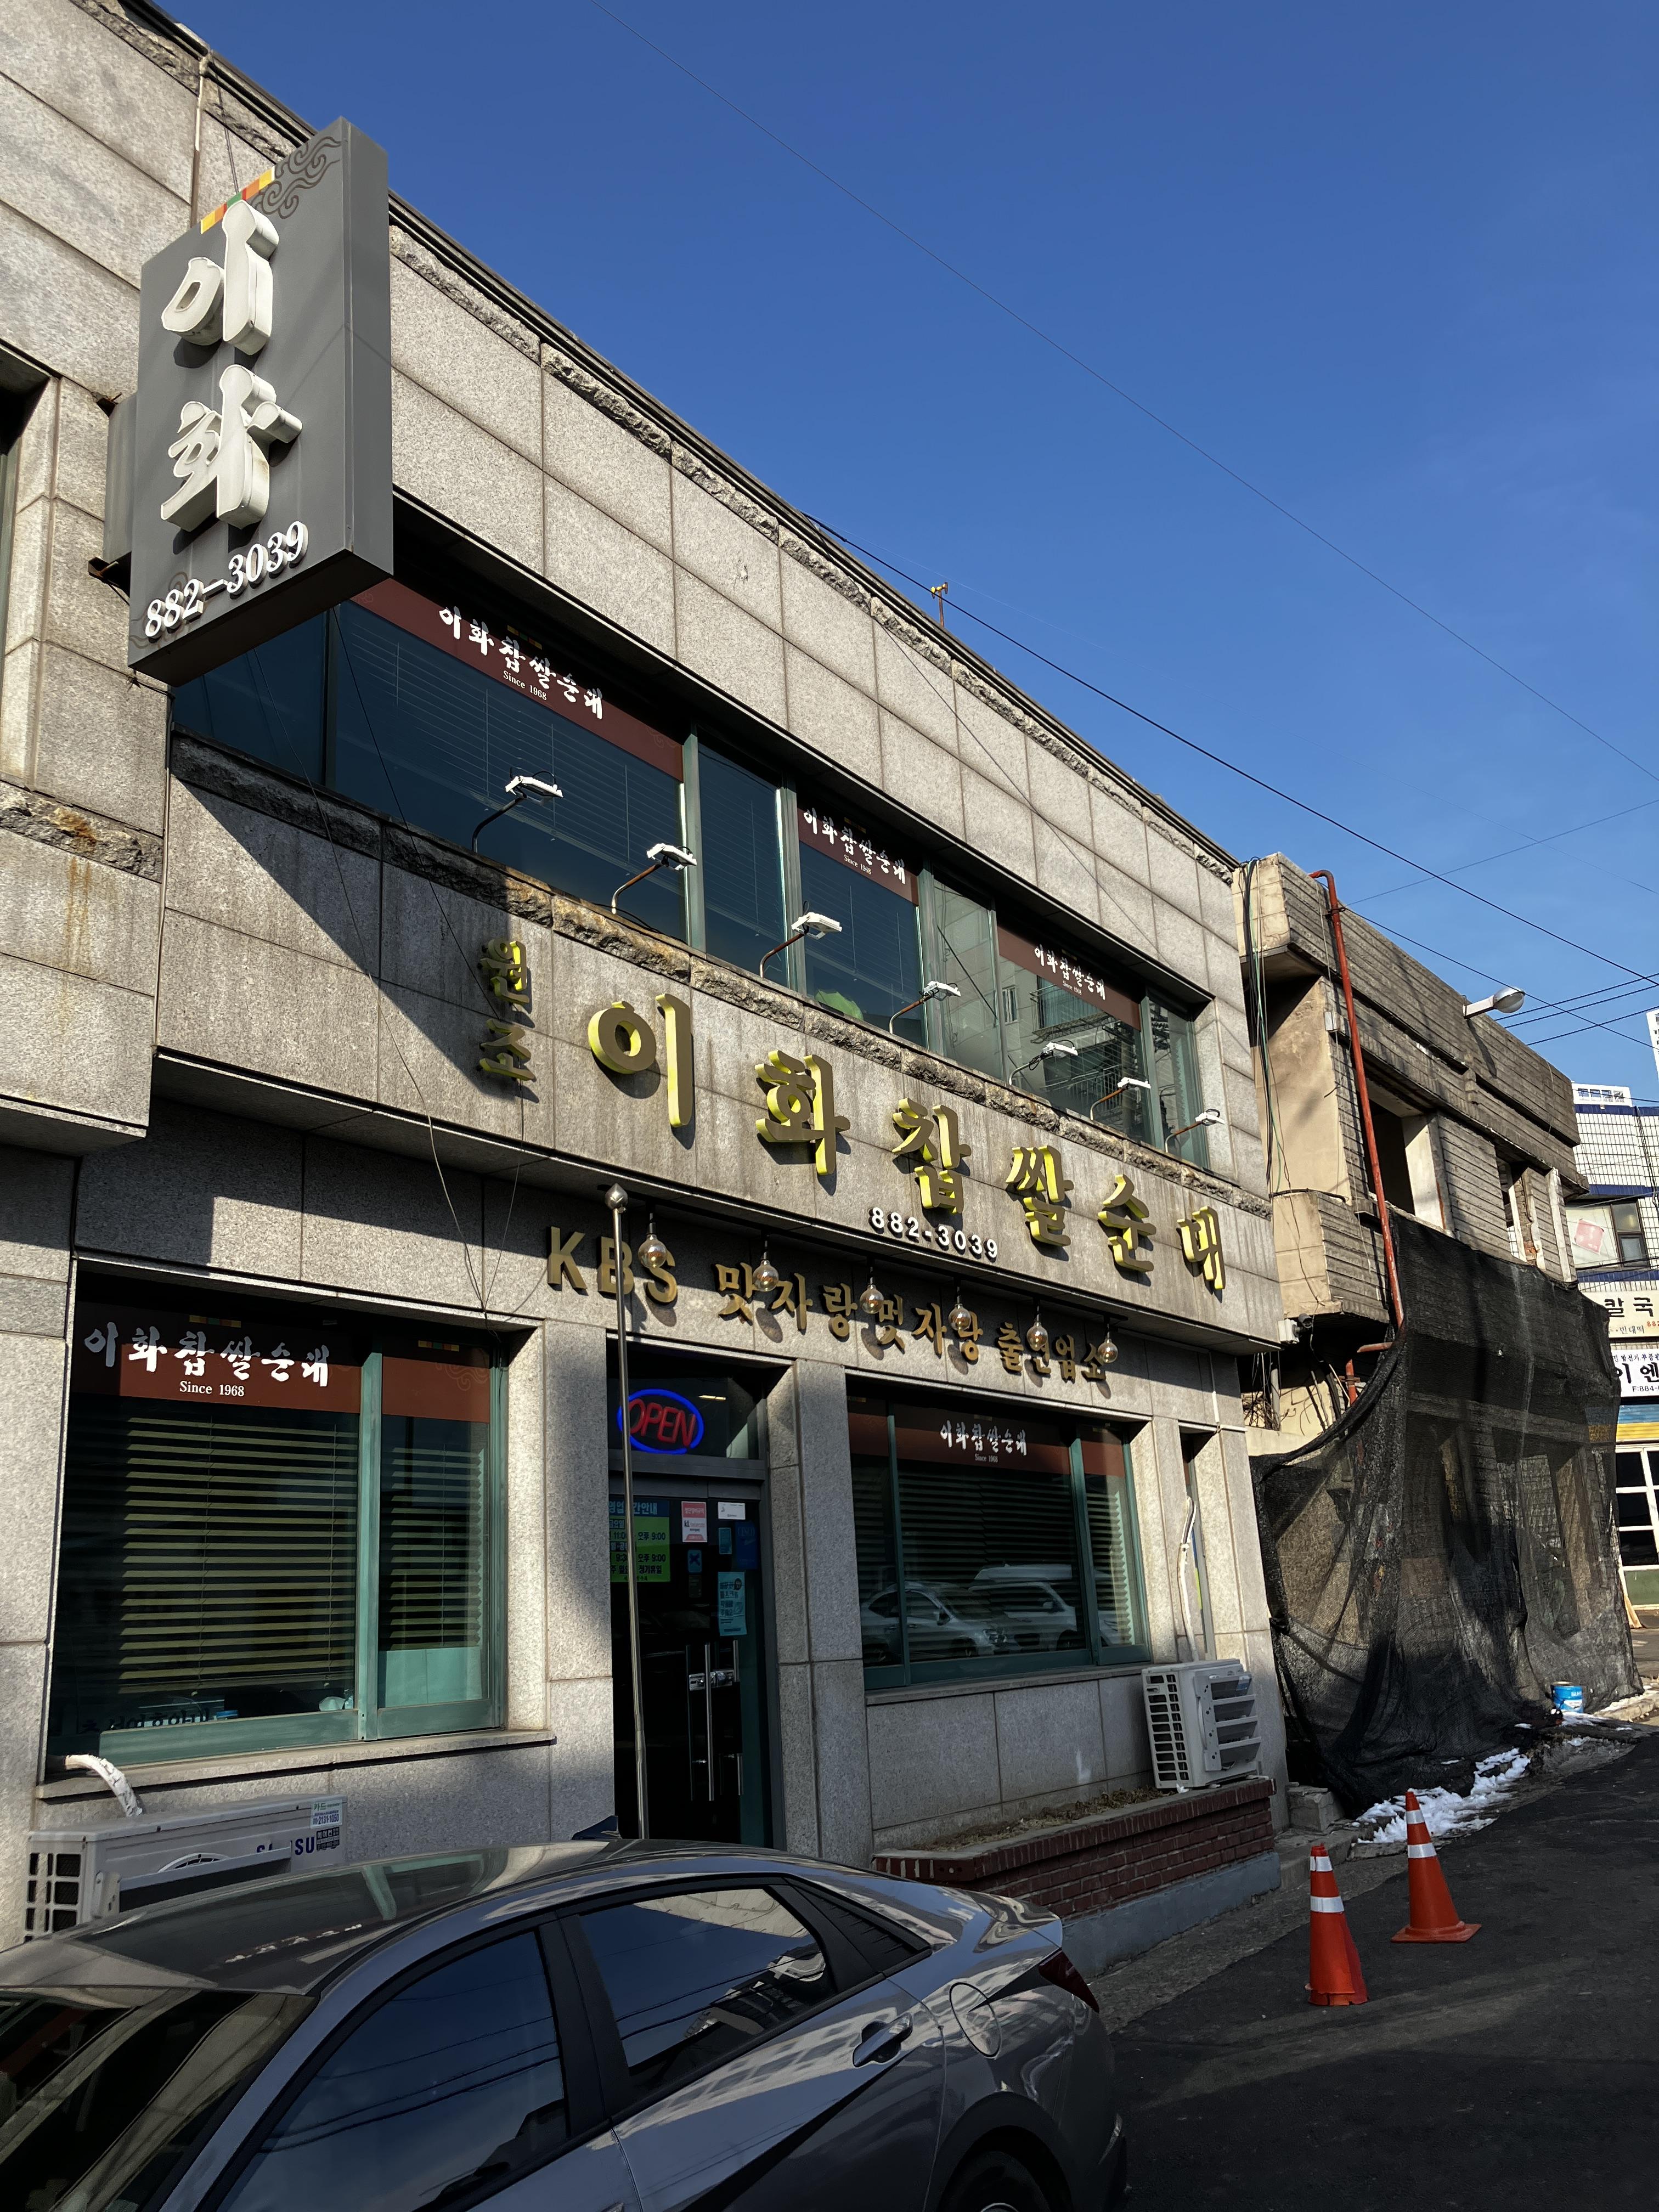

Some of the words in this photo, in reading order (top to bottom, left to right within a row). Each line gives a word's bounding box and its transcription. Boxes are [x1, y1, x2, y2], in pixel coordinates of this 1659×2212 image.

[161, 199, 303, 529] 이화
[145, 521, 308, 640] 882-3039
[439, 606, 603, 720] 이화찹쌀순대
[503, 670, 526, 689] Since
[529, 685, 547, 701] 1968
[803, 808, 905, 884] 이화찹쌀순대
[844, 854, 859, 867] Since
[479, 937, 536, 1081] 원조
[871, 1207, 997, 1259] 882-3039
[548, 1226, 678, 1304] KBS
[84, 1322, 329, 1387] 이화찹쌀순대
[179, 1380, 213, 1395] Since
[218, 1384, 245, 1397] 1968
[629, 1398, 696, 1447] OPEN
[651, 1532, 666, 1541] 9:00
[651, 1554, 666, 1562] 9:00
